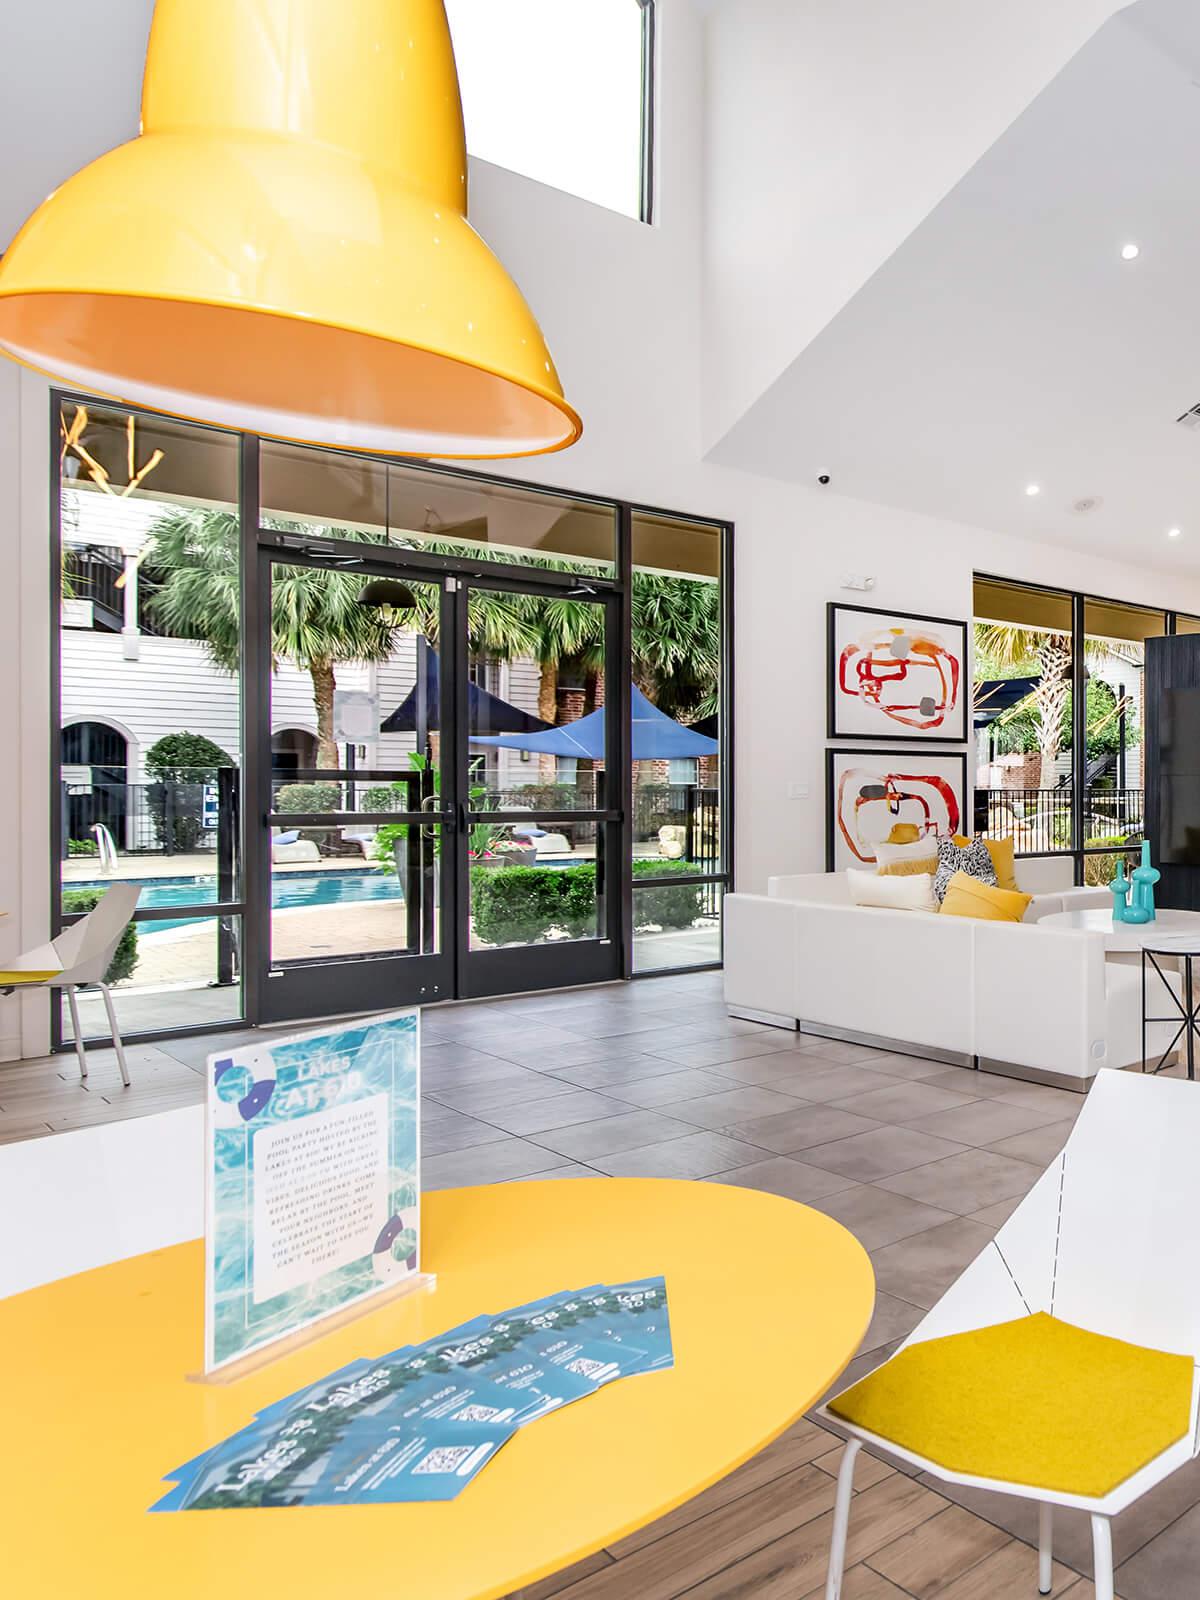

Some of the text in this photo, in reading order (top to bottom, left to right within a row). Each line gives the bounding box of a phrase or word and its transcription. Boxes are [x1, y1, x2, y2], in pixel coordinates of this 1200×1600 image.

[297, 1056, 351, 1080] LAKES
[266, 1148, 289, 1160] POOL
[292, 1139, 317, 1151] PARTY
[319, 1128, 350, 1143] HOSTED
[362, 1120, 377, 1129] THE
[271, 1136, 290, 1148] JOIN
[305, 1127, 321, 1137] FOR
[265, 1158, 292, 1172] LAKES
[349, 1129, 379, 1144] KICKING
[355, 1149, 379, 1163] GREAT
[291, 1164, 306, 1175] THE
[309, 1152, 342, 1168] SUMMER
[312, 1199, 327, 1211] THE
[321, 1218, 336, 1229] THE
[509, 1364, 534, 1377] 610
[305, 1369, 391, 1412] Lakes
[214, 1439, 298, 1493] Lakes
